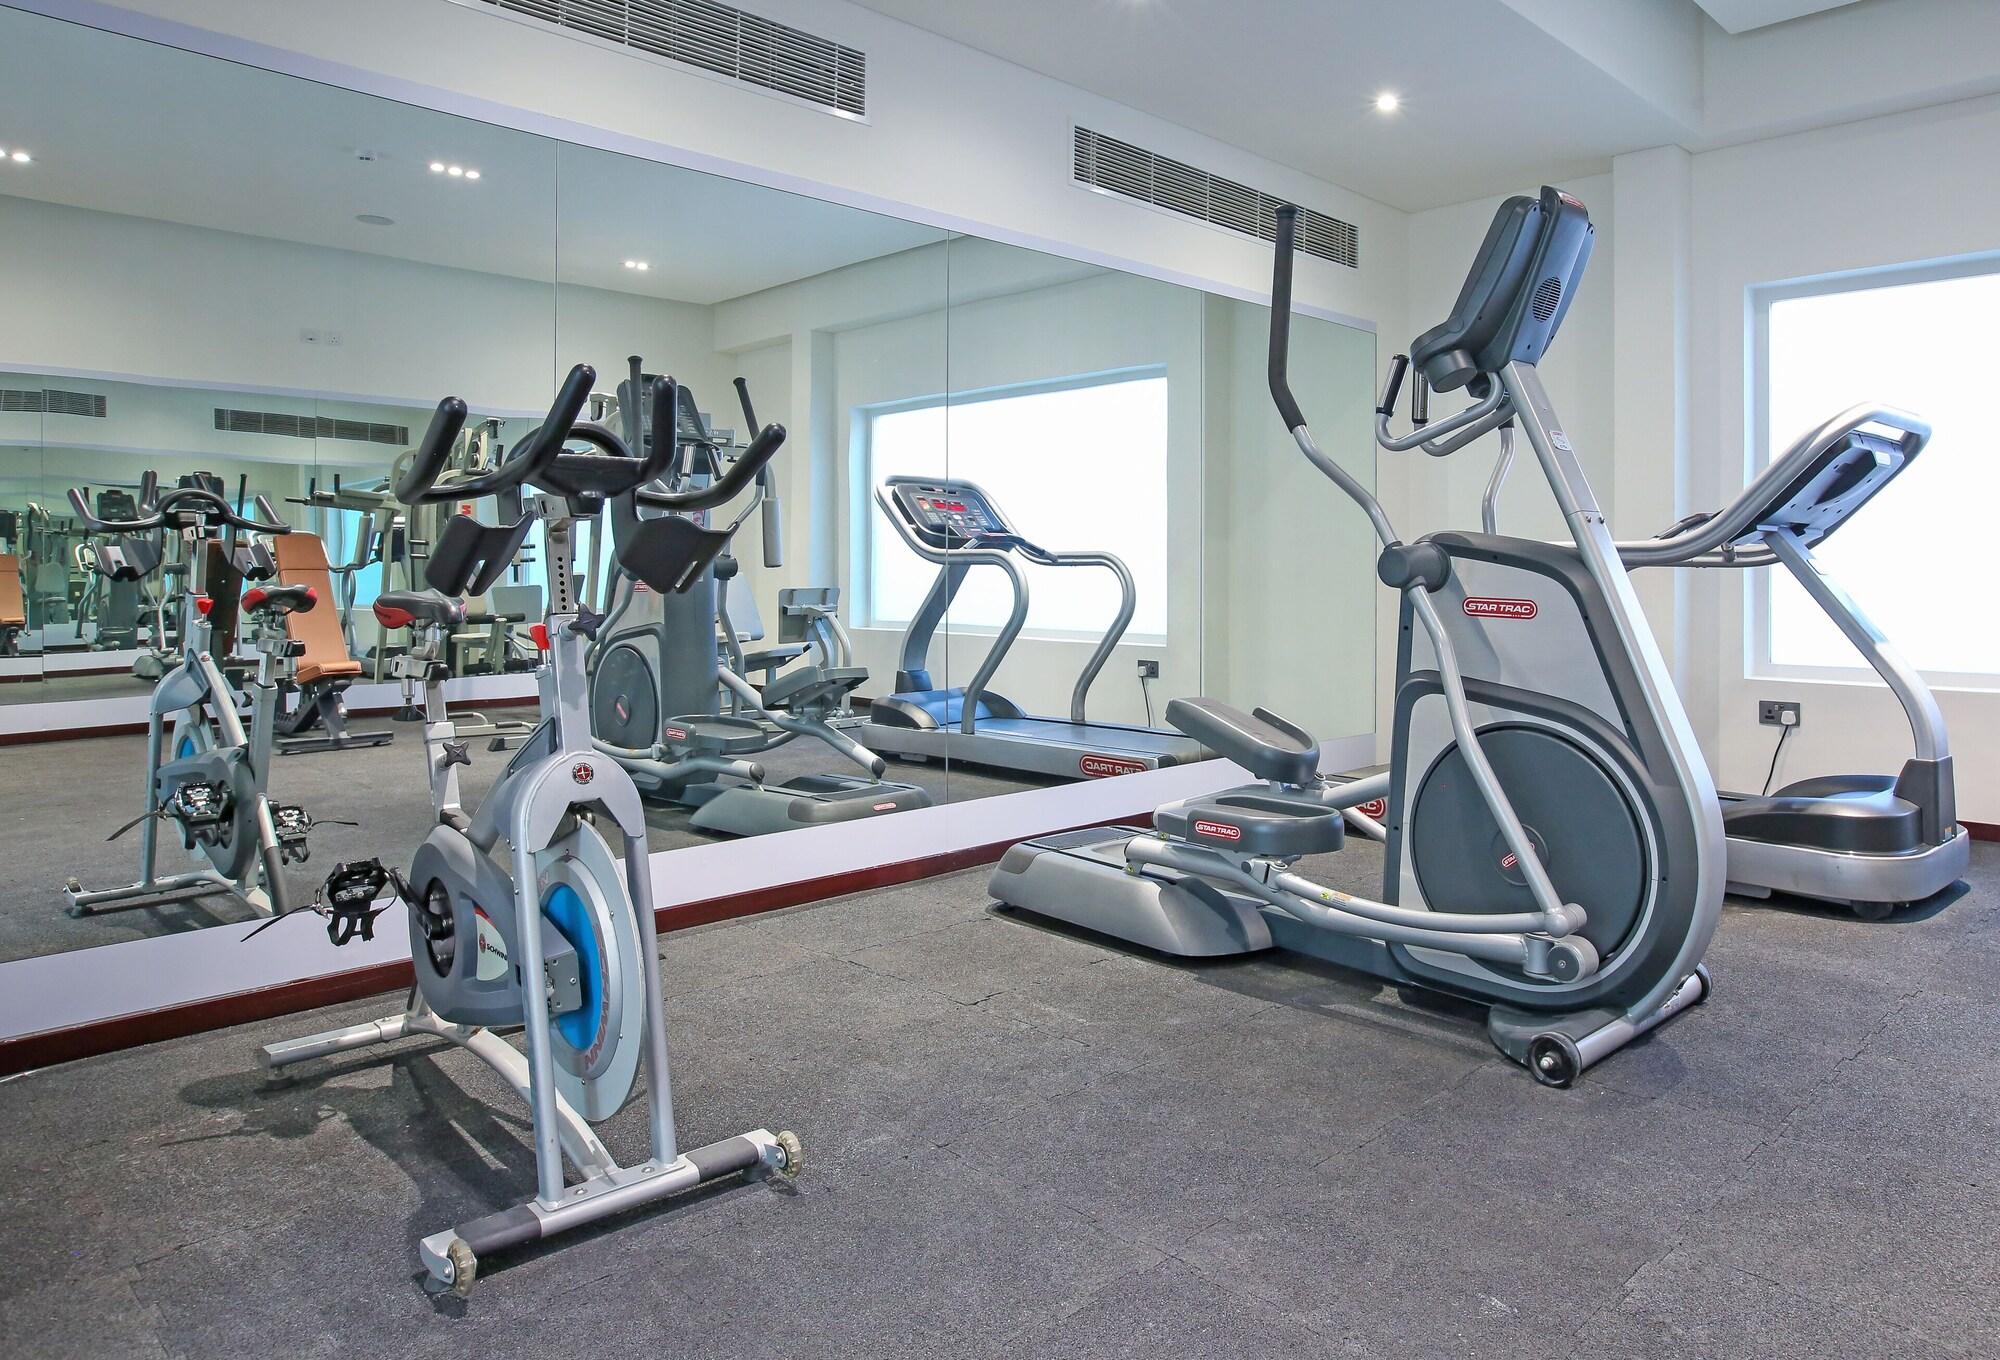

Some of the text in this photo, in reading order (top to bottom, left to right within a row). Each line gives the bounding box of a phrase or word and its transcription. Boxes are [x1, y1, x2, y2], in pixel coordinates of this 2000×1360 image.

[1466, 602, 1531, 613] STAR TRAC
[1198, 823, 1237, 836] STAR TRAC
